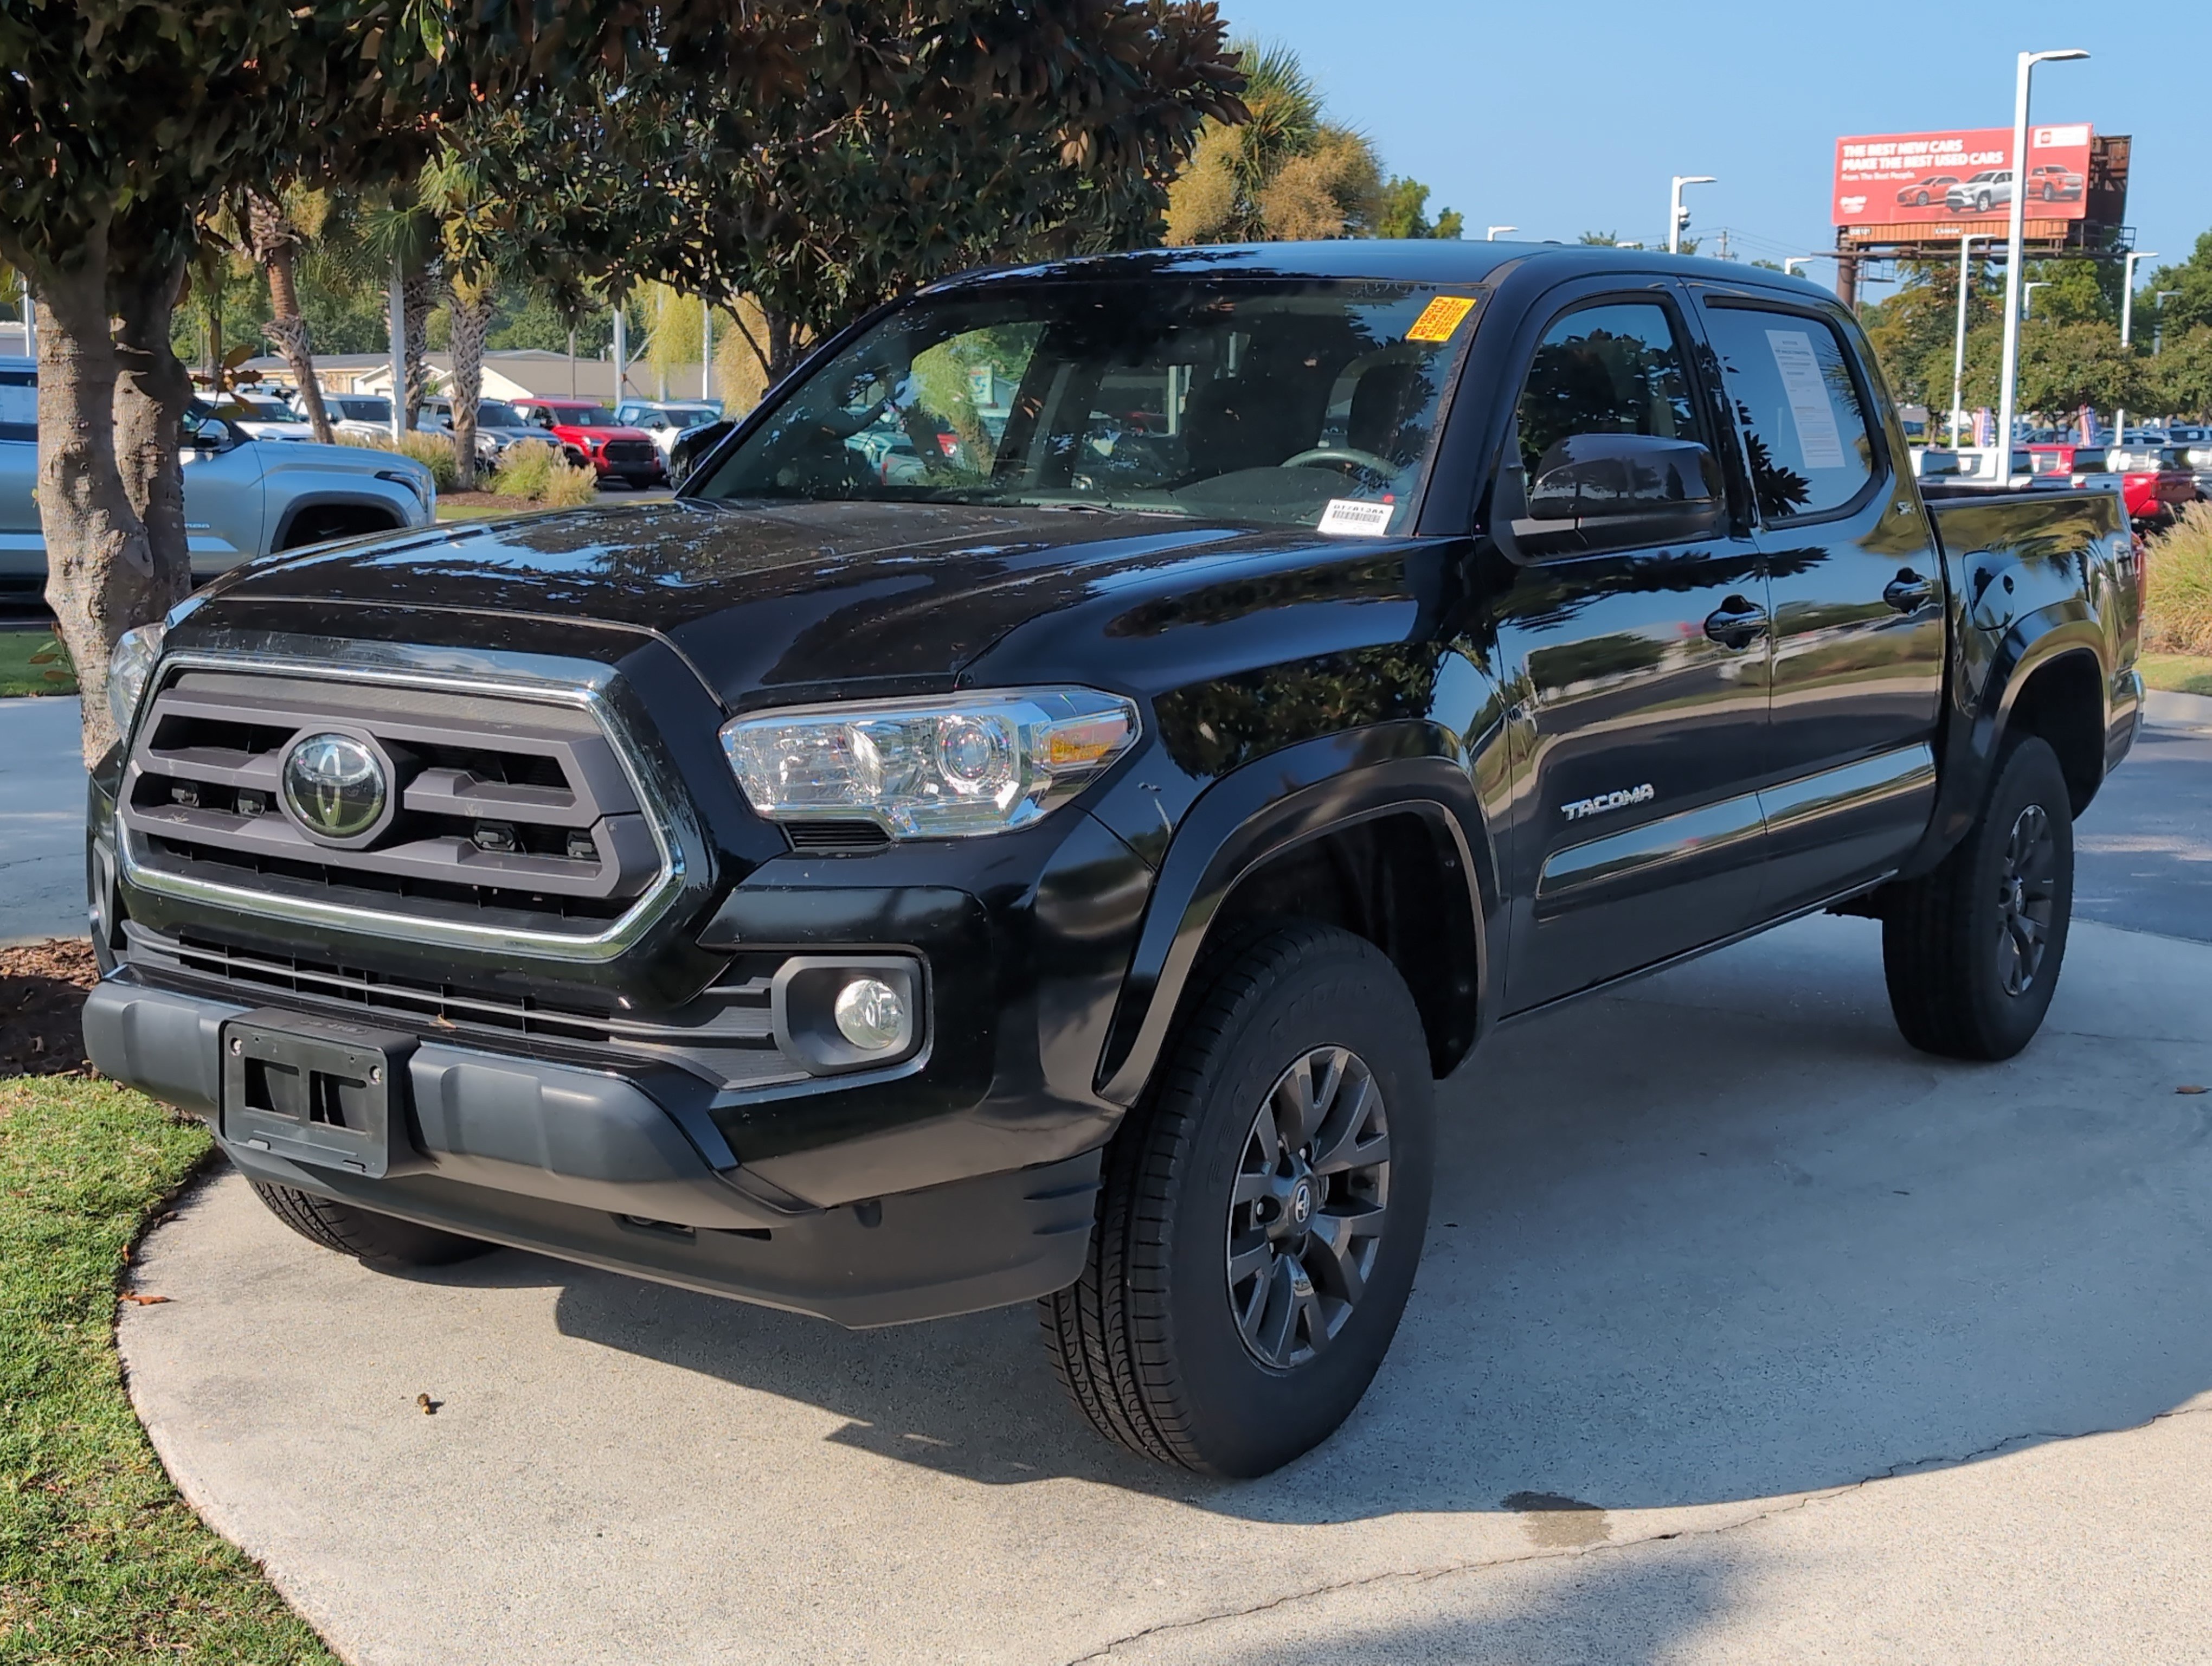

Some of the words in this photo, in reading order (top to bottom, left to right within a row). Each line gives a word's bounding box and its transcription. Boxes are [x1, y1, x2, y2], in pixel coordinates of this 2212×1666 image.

[1843, 145, 1866, 157] THE
[1868, 144, 1896, 156] BEST
[1898, 142, 1928, 155] NEW
[1930, 139, 1963, 153] CARS
[1843, 158, 1877, 171] MAKE
[1879, 157, 1902, 169] THE
[1904, 155, 1933, 168] BEST
[1935, 153, 1968, 166] USED
[1970, 151, 2003, 165] CARS
[1560, 783, 1654, 821] TACOMA
